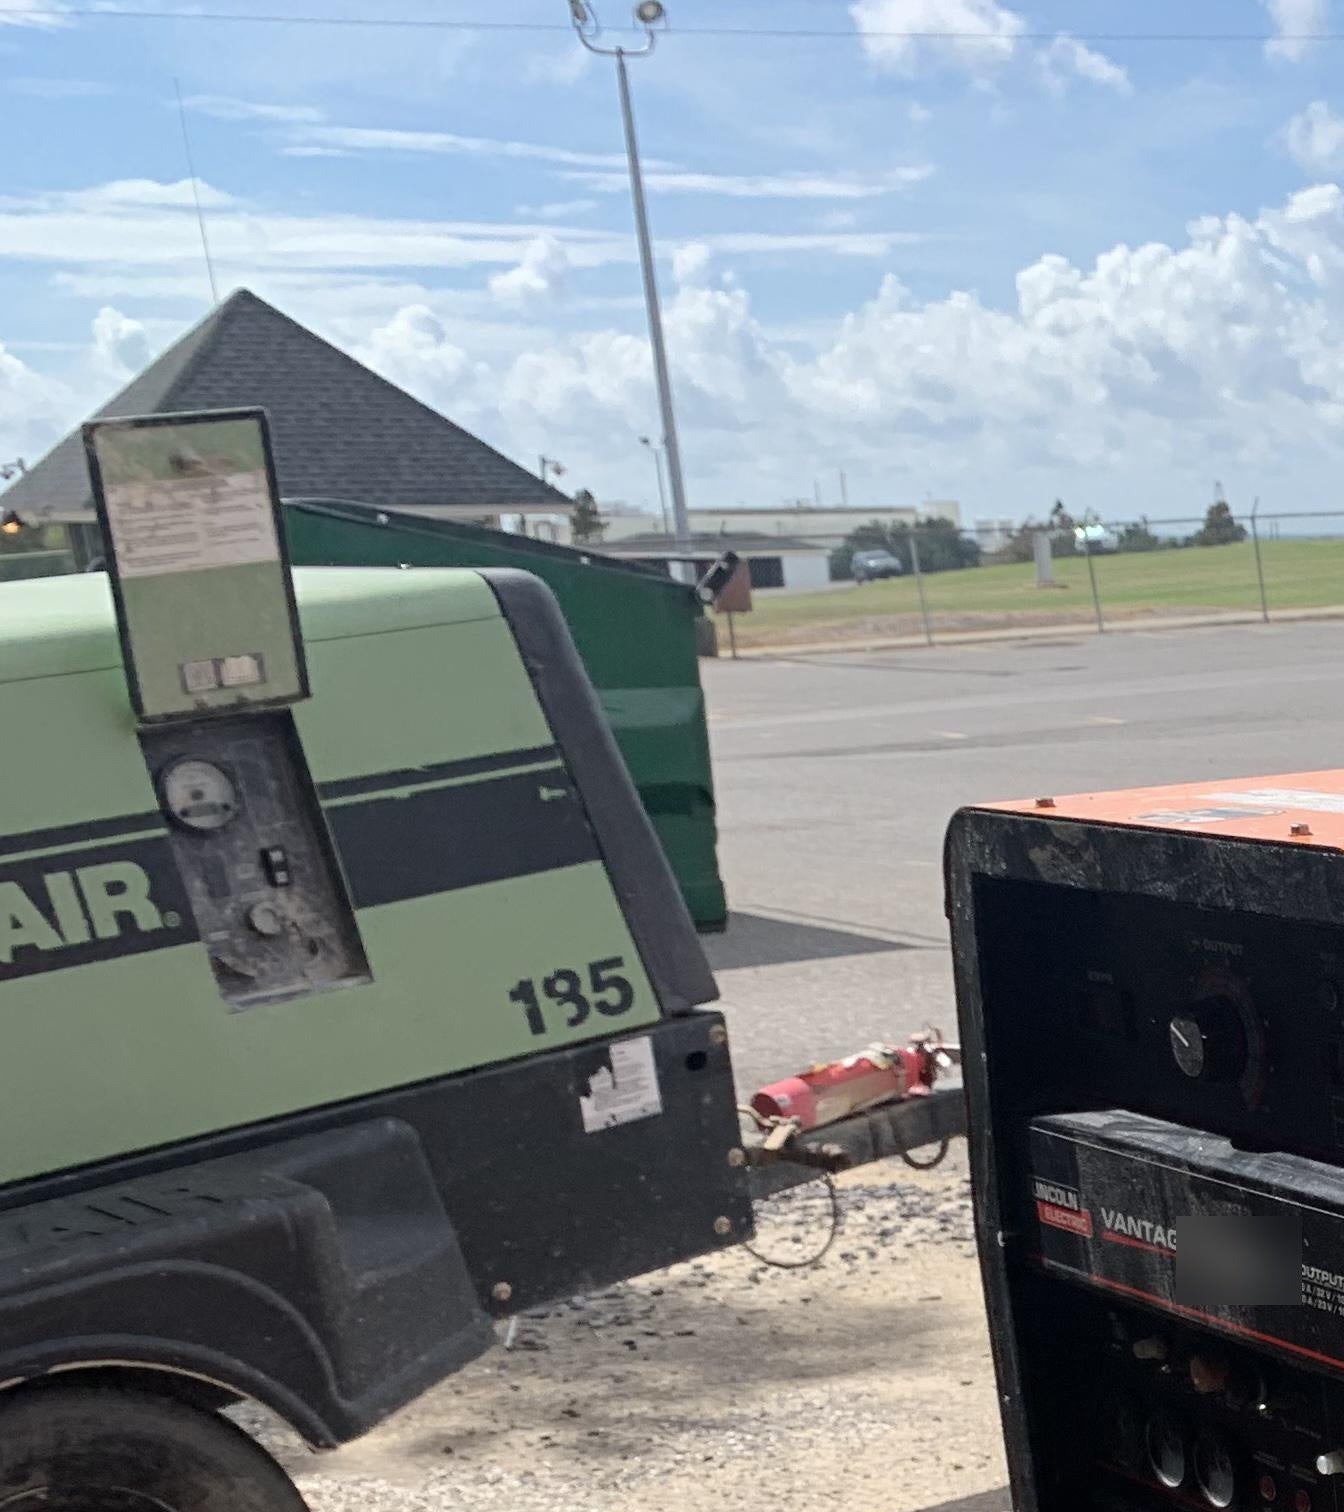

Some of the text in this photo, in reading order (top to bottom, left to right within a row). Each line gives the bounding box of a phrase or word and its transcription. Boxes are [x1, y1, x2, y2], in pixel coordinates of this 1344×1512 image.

[0, 860, 164, 963] AIR
[509, 956, 634, 1035] 185
[1101, 1207, 1177, 1252] VANTAG
